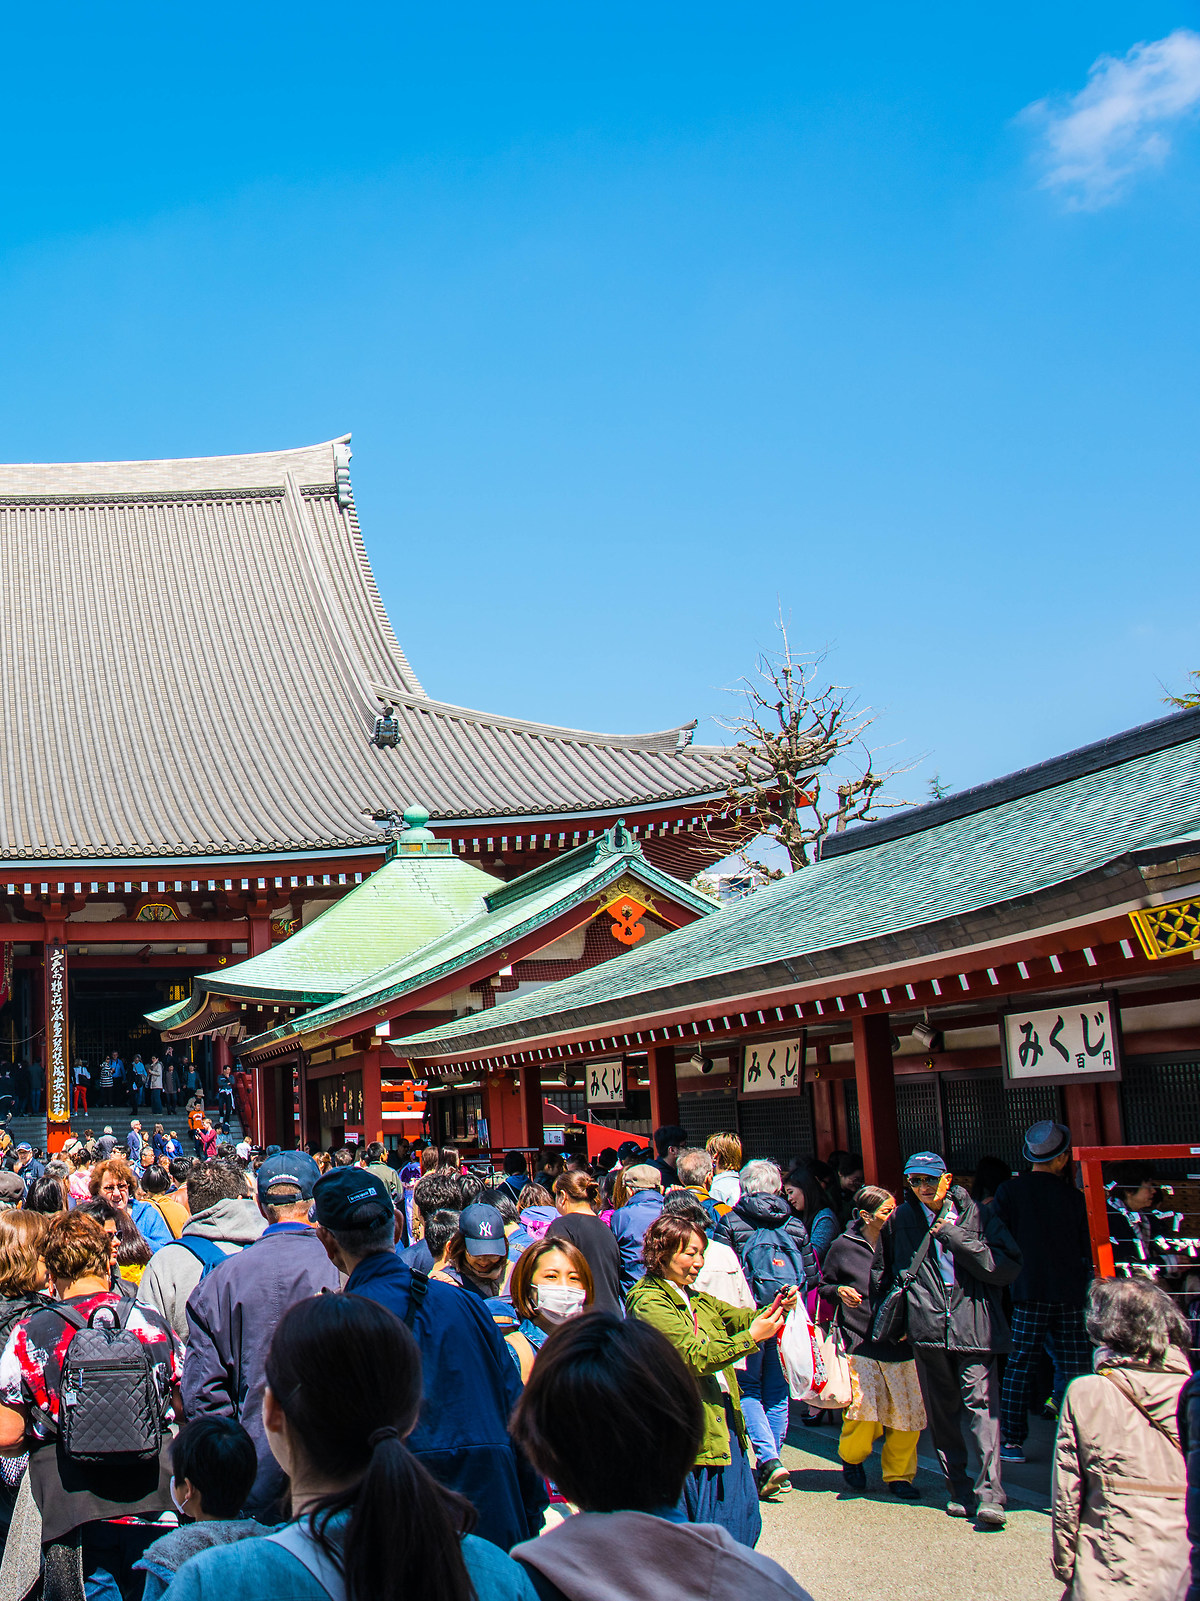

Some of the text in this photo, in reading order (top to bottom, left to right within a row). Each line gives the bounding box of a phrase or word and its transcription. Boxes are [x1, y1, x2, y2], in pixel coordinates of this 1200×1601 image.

[1019, 1012, 1106, 1067] みくじ
[748, 1044, 799, 1083] みくじ
[591, 1068, 621, 1097] みくじ
[479, 1221, 493, 1237] NY
